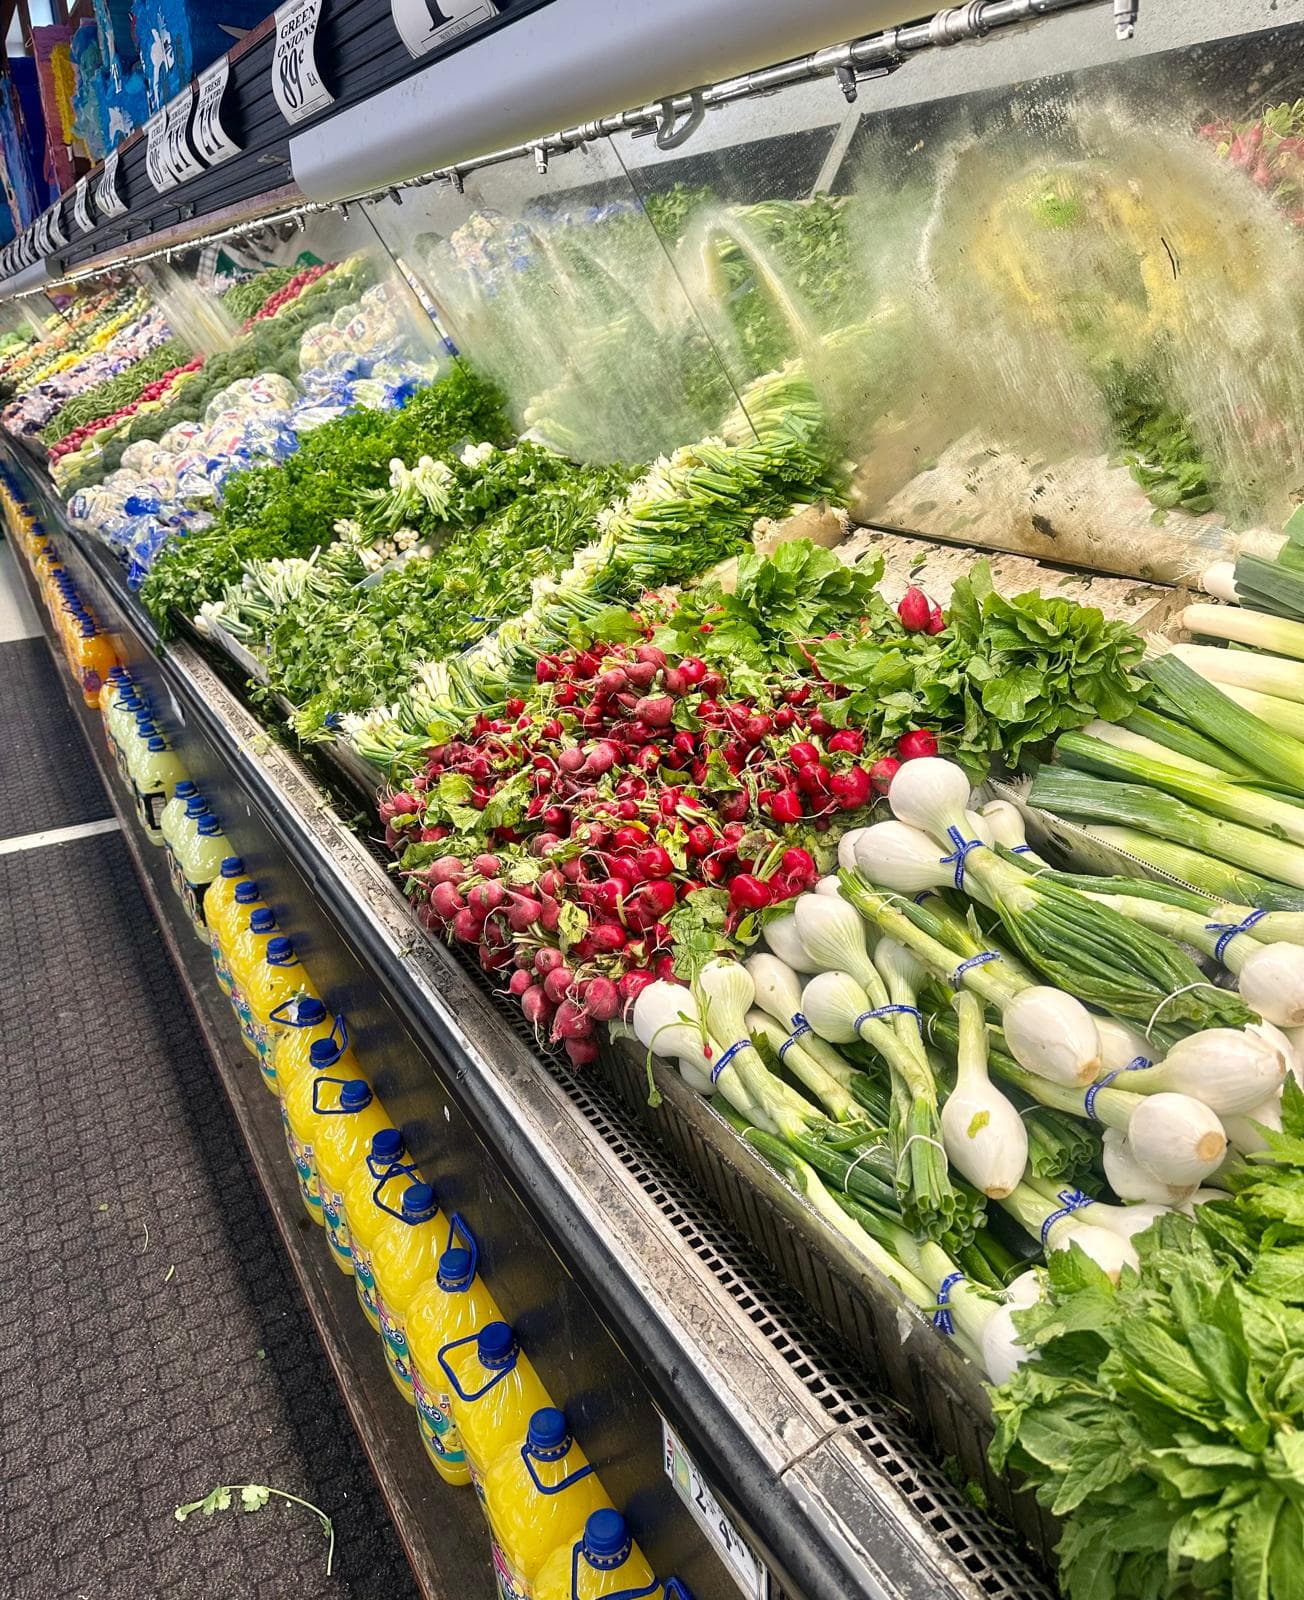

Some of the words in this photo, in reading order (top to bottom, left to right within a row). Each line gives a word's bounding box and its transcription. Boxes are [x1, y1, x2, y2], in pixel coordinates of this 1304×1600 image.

[281, 2, 317, 39] GREEN
[278, 21, 316, 57] ONIONS
[204, 76, 221, 95] FRESH
[307, 72, 318, 86] EA
